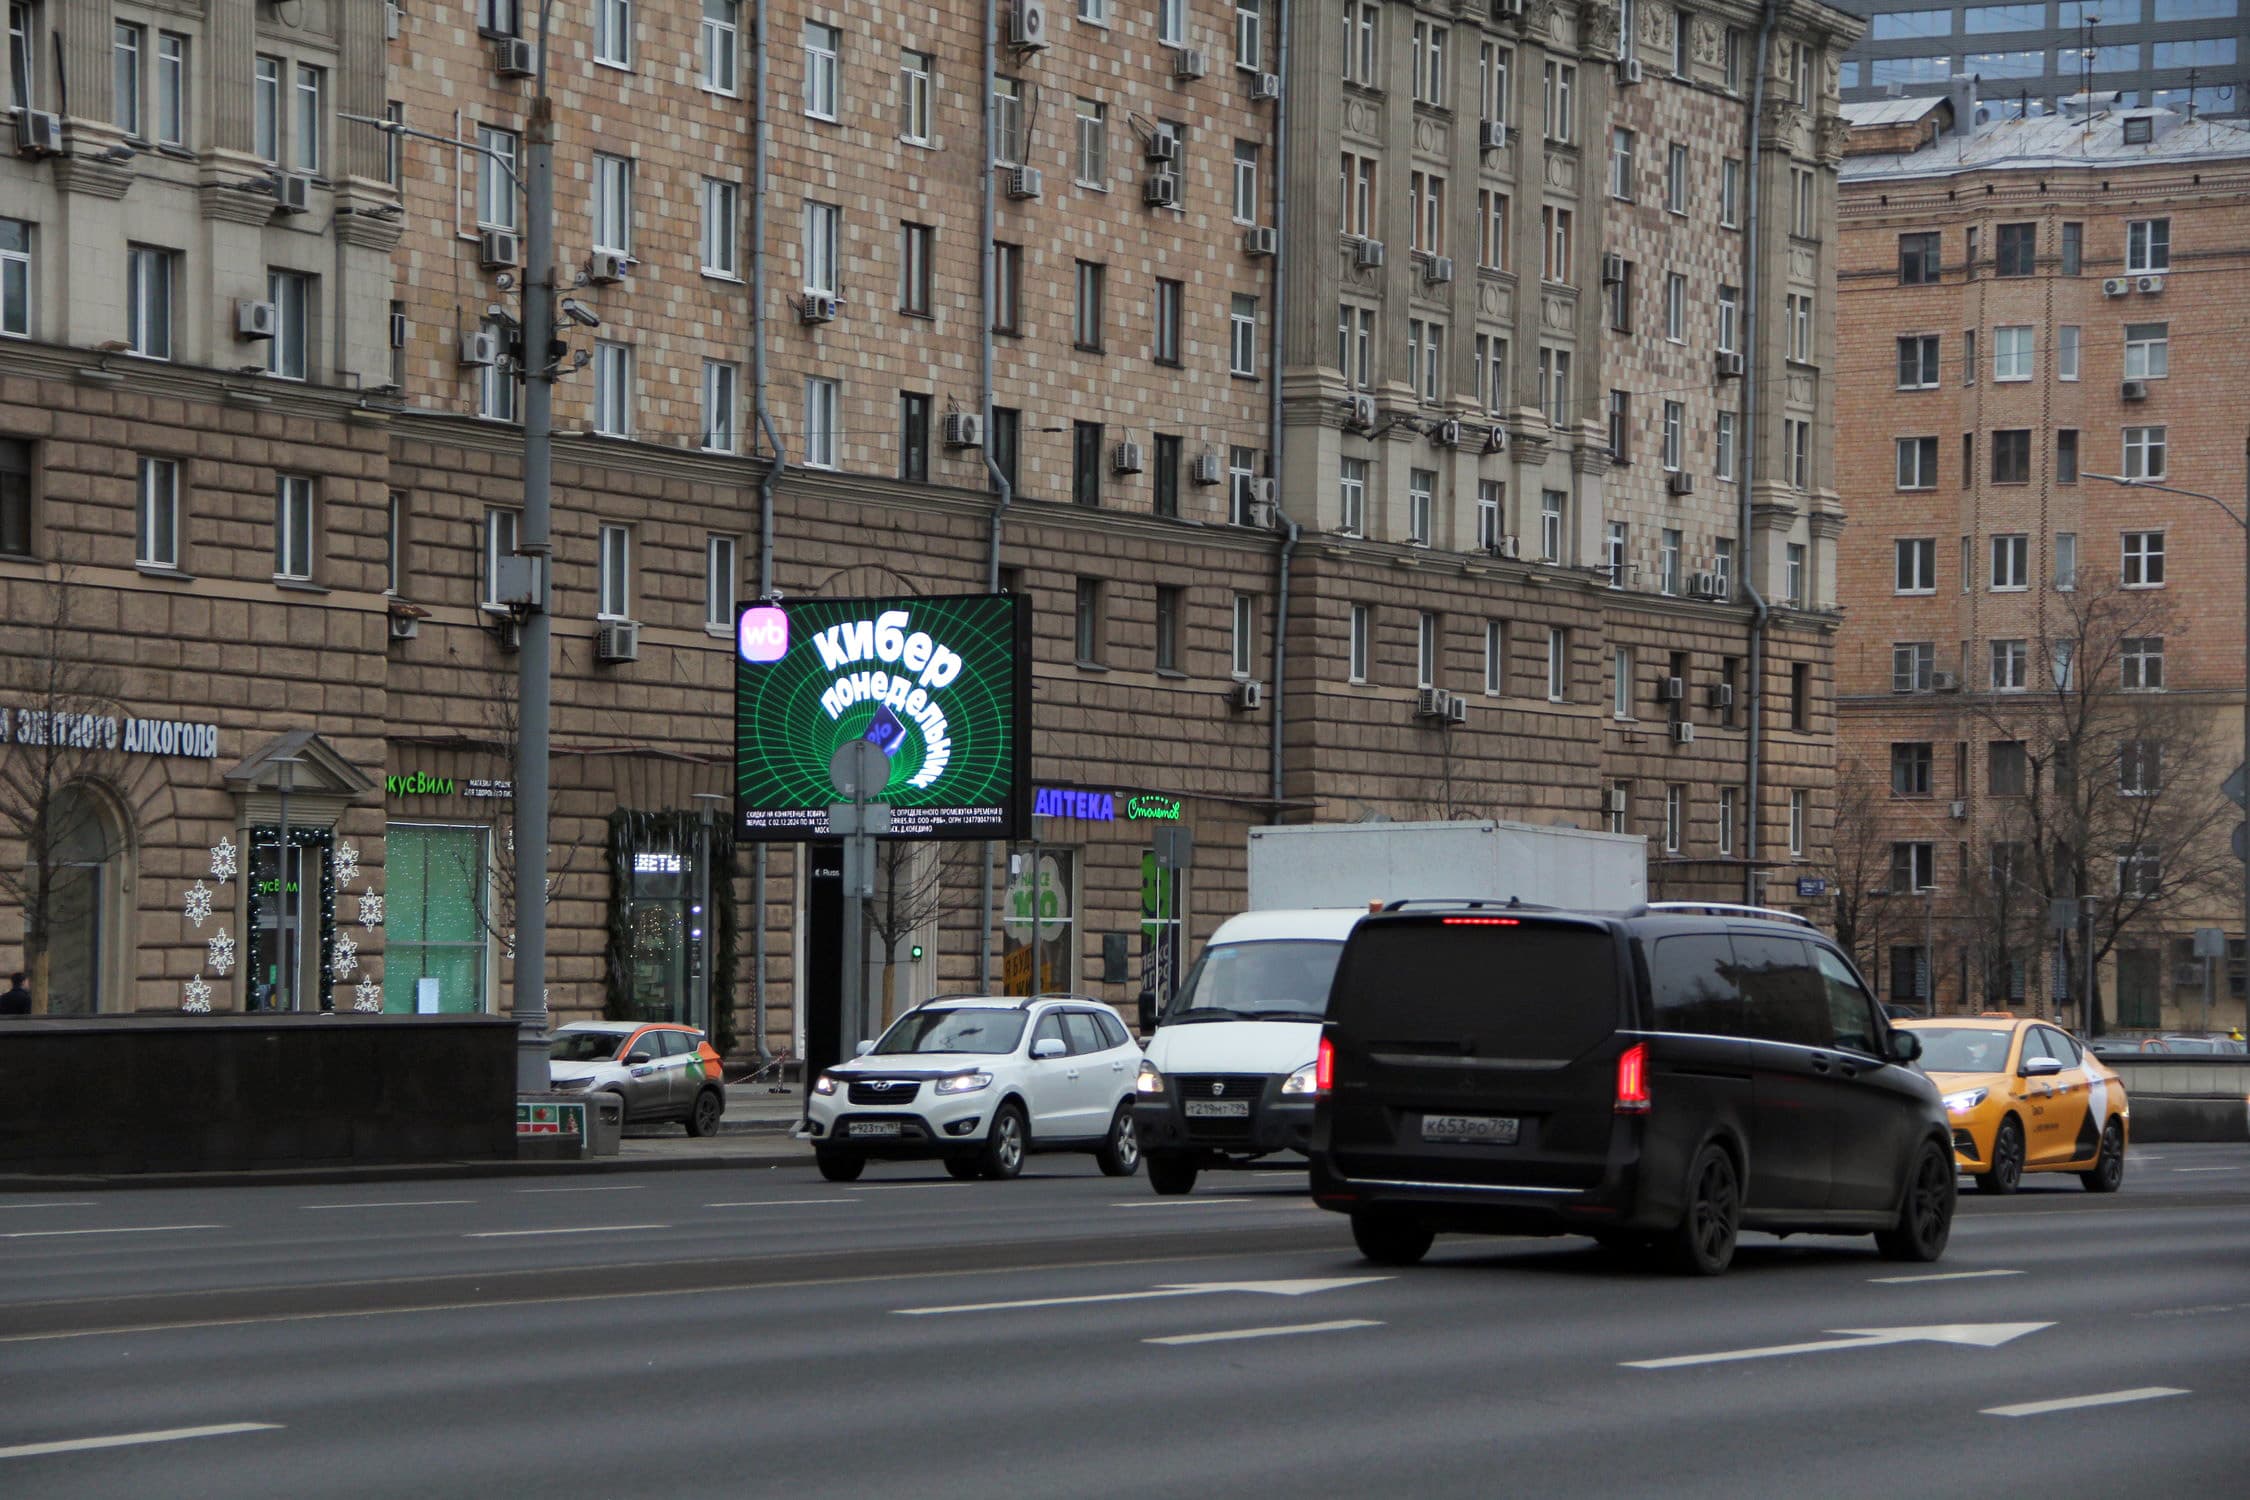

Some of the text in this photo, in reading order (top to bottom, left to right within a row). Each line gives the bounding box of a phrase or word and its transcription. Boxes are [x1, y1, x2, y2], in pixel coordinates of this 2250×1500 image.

[744, 617, 784, 646] wb
[123, 717, 218, 758] АЛКОГОЛЯ
[820, 670, 951, 789] понедельник
[385, 771, 454, 799] кусВилл
[1034, 787, 1115, 821] АПТЕКА
